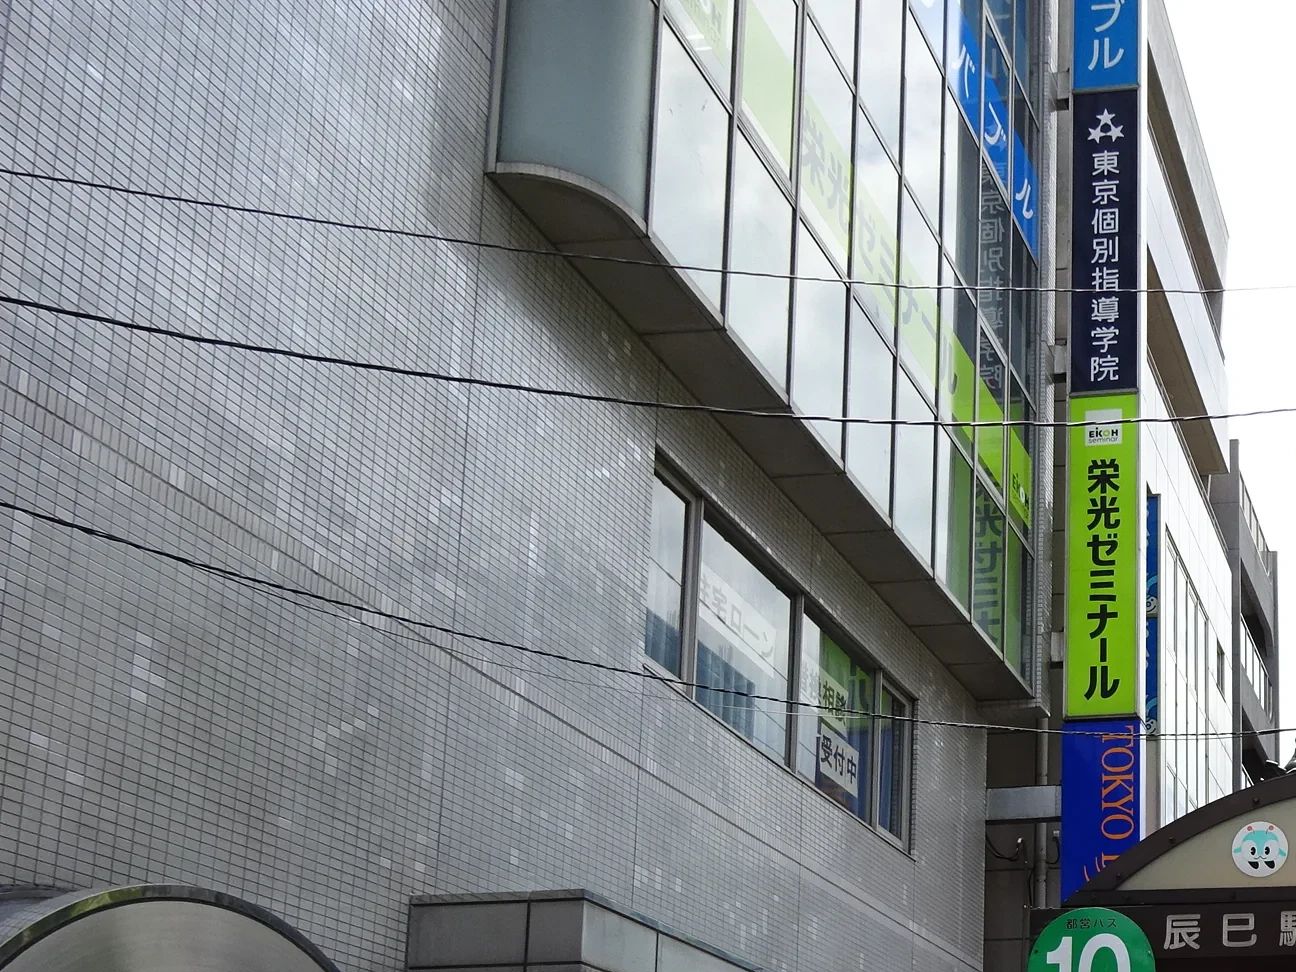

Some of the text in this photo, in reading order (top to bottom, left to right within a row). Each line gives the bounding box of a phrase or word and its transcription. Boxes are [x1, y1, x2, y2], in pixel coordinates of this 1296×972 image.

[1088, 0, 1125, 71] ブル
[1090, 151, 1119, 382] 東京個別指導学院
[1084, 459, 1120, 700] 栄光ゼミナール
[820, 734, 856, 784] 受付中
[1101, 725, 1134, 840] TOKYO
